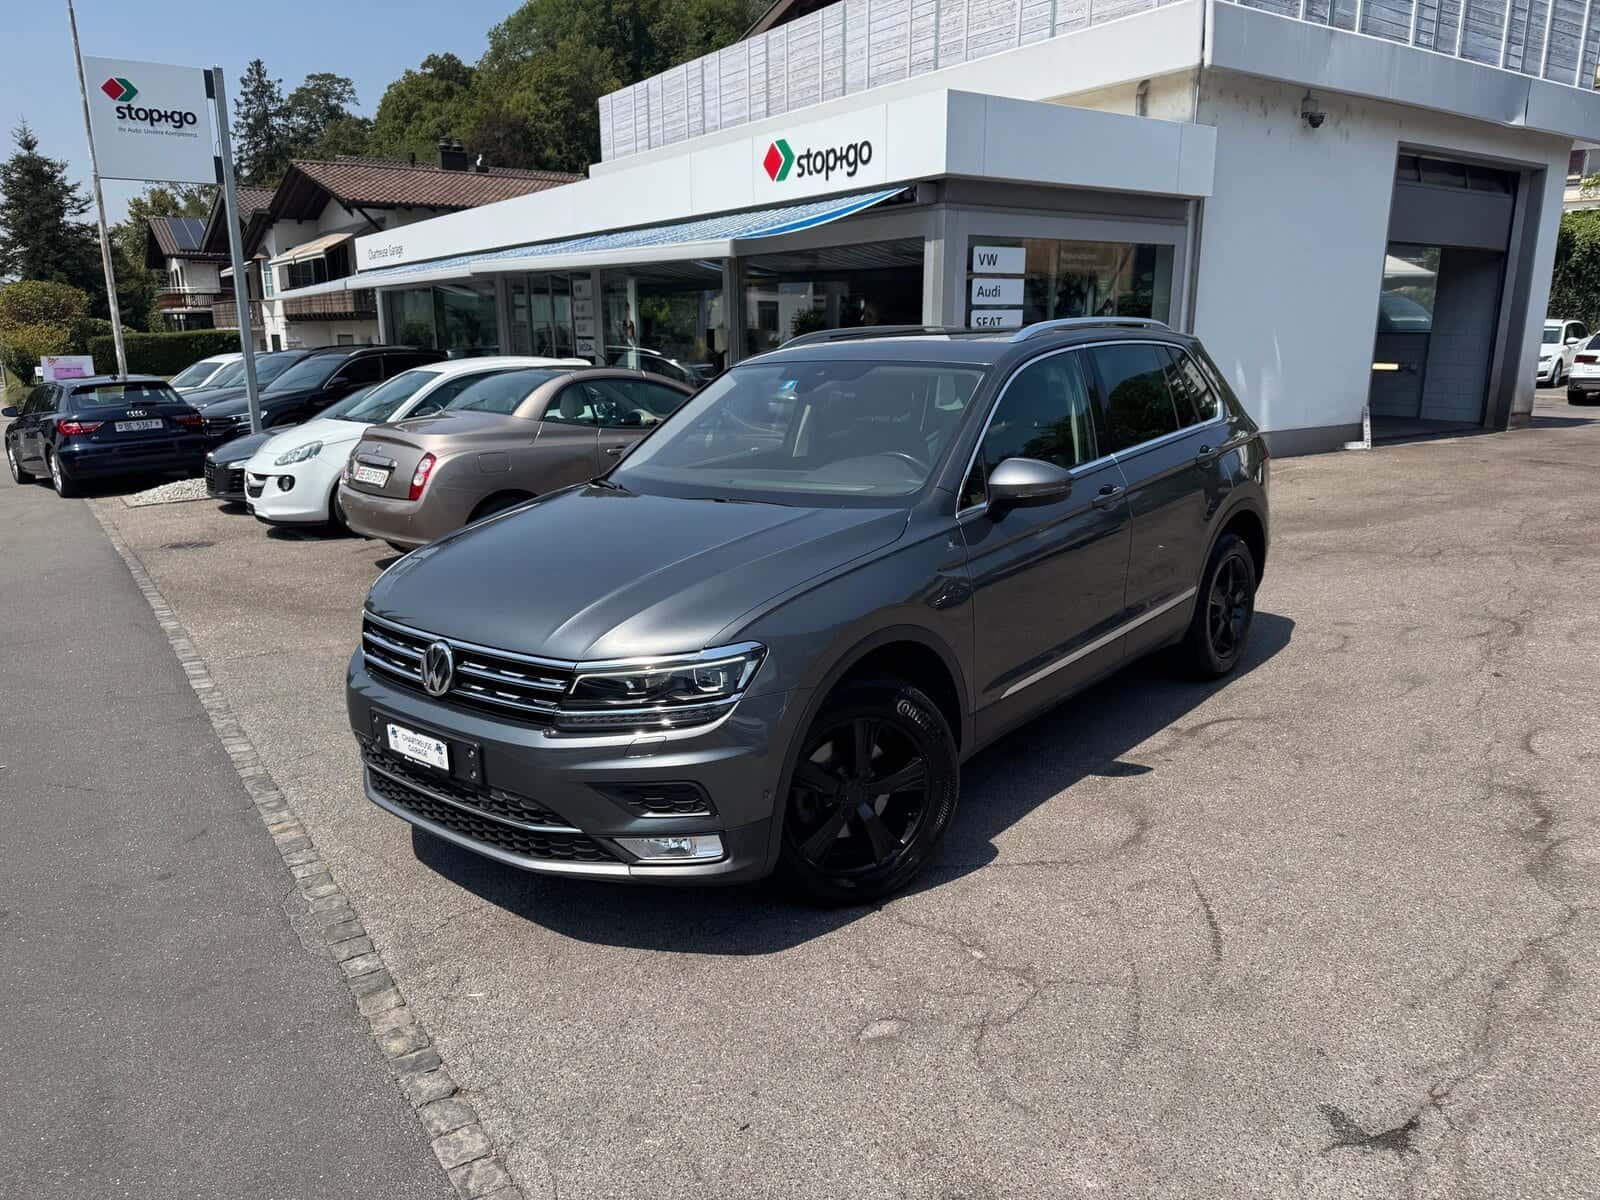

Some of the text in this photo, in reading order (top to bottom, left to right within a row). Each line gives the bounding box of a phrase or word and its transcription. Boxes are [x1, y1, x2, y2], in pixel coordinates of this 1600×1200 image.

[116, 103, 197, 128] stop+go
[797, 140, 872, 181] stop+go
[978, 253, 998, 267] VW
[976, 285, 1001, 298] Audi
[976, 316, 1003, 327] SEAT
[408, 744, 428, 756] GARAGE
